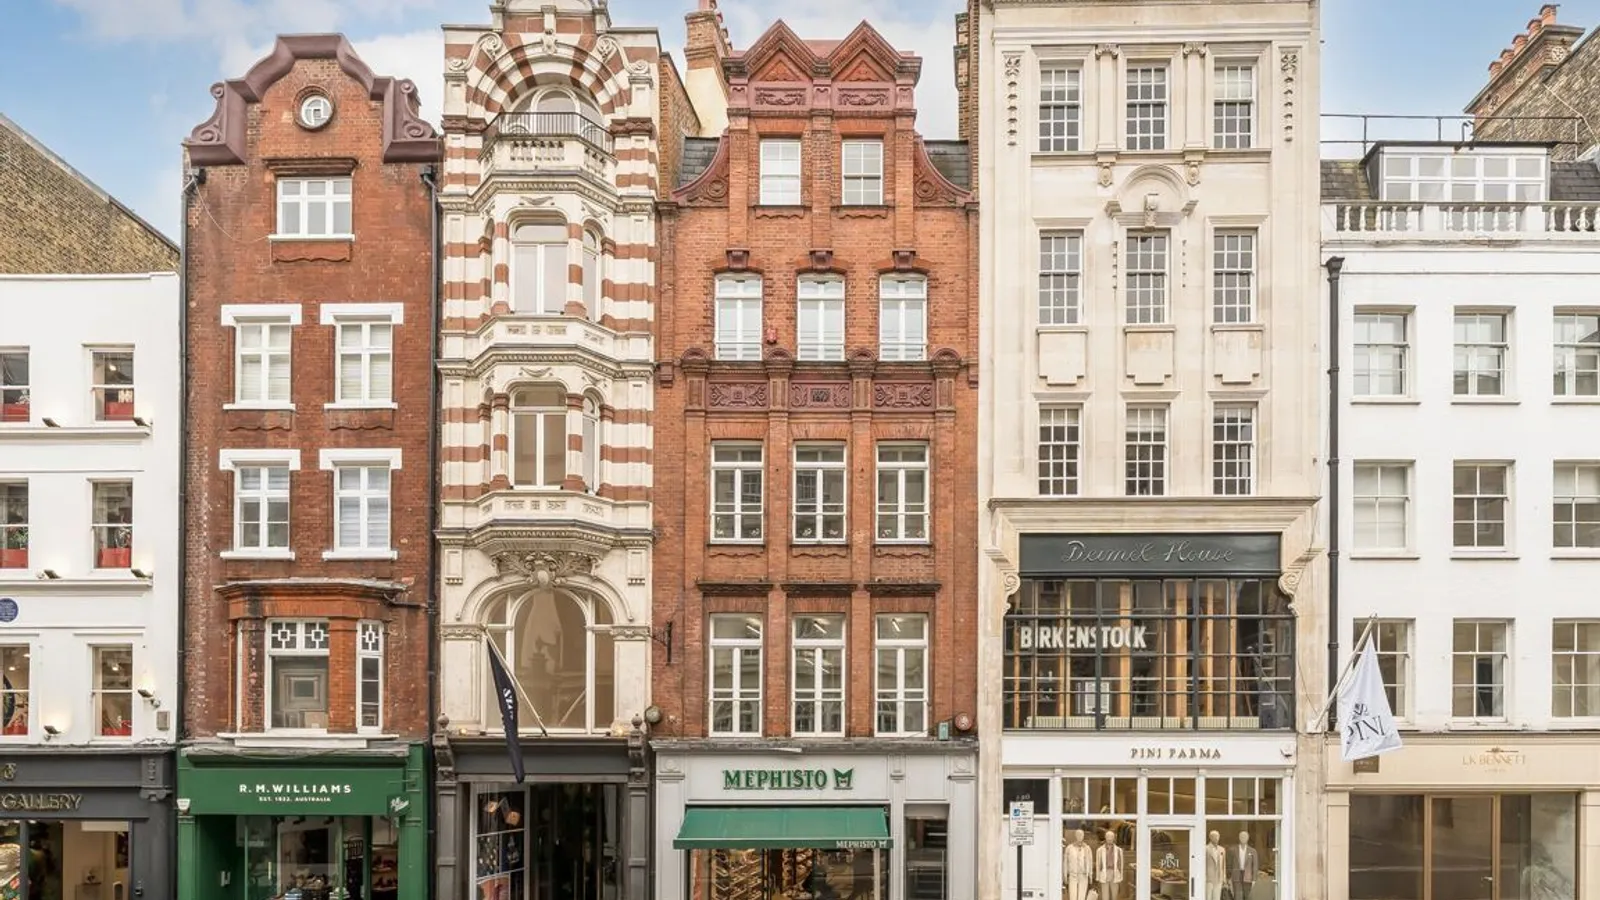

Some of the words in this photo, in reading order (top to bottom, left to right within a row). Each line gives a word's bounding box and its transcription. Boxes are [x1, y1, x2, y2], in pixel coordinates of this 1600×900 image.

[1163, 540, 1236, 562] House
[1020, 625, 1147, 648] BIRKENSTOCK
[1130, 748, 1162, 759] PINI
[1168, 748, 1221, 759] PARMA
[1479, 754, 1526, 766] BENNETT
[722, 769, 828, 791] MEPHISTO
[1, 793, 82, 810] GALLERY
[294, 795, 332, 803] AUSTRALIA
[835, 840, 876, 849] MEPHISTO
